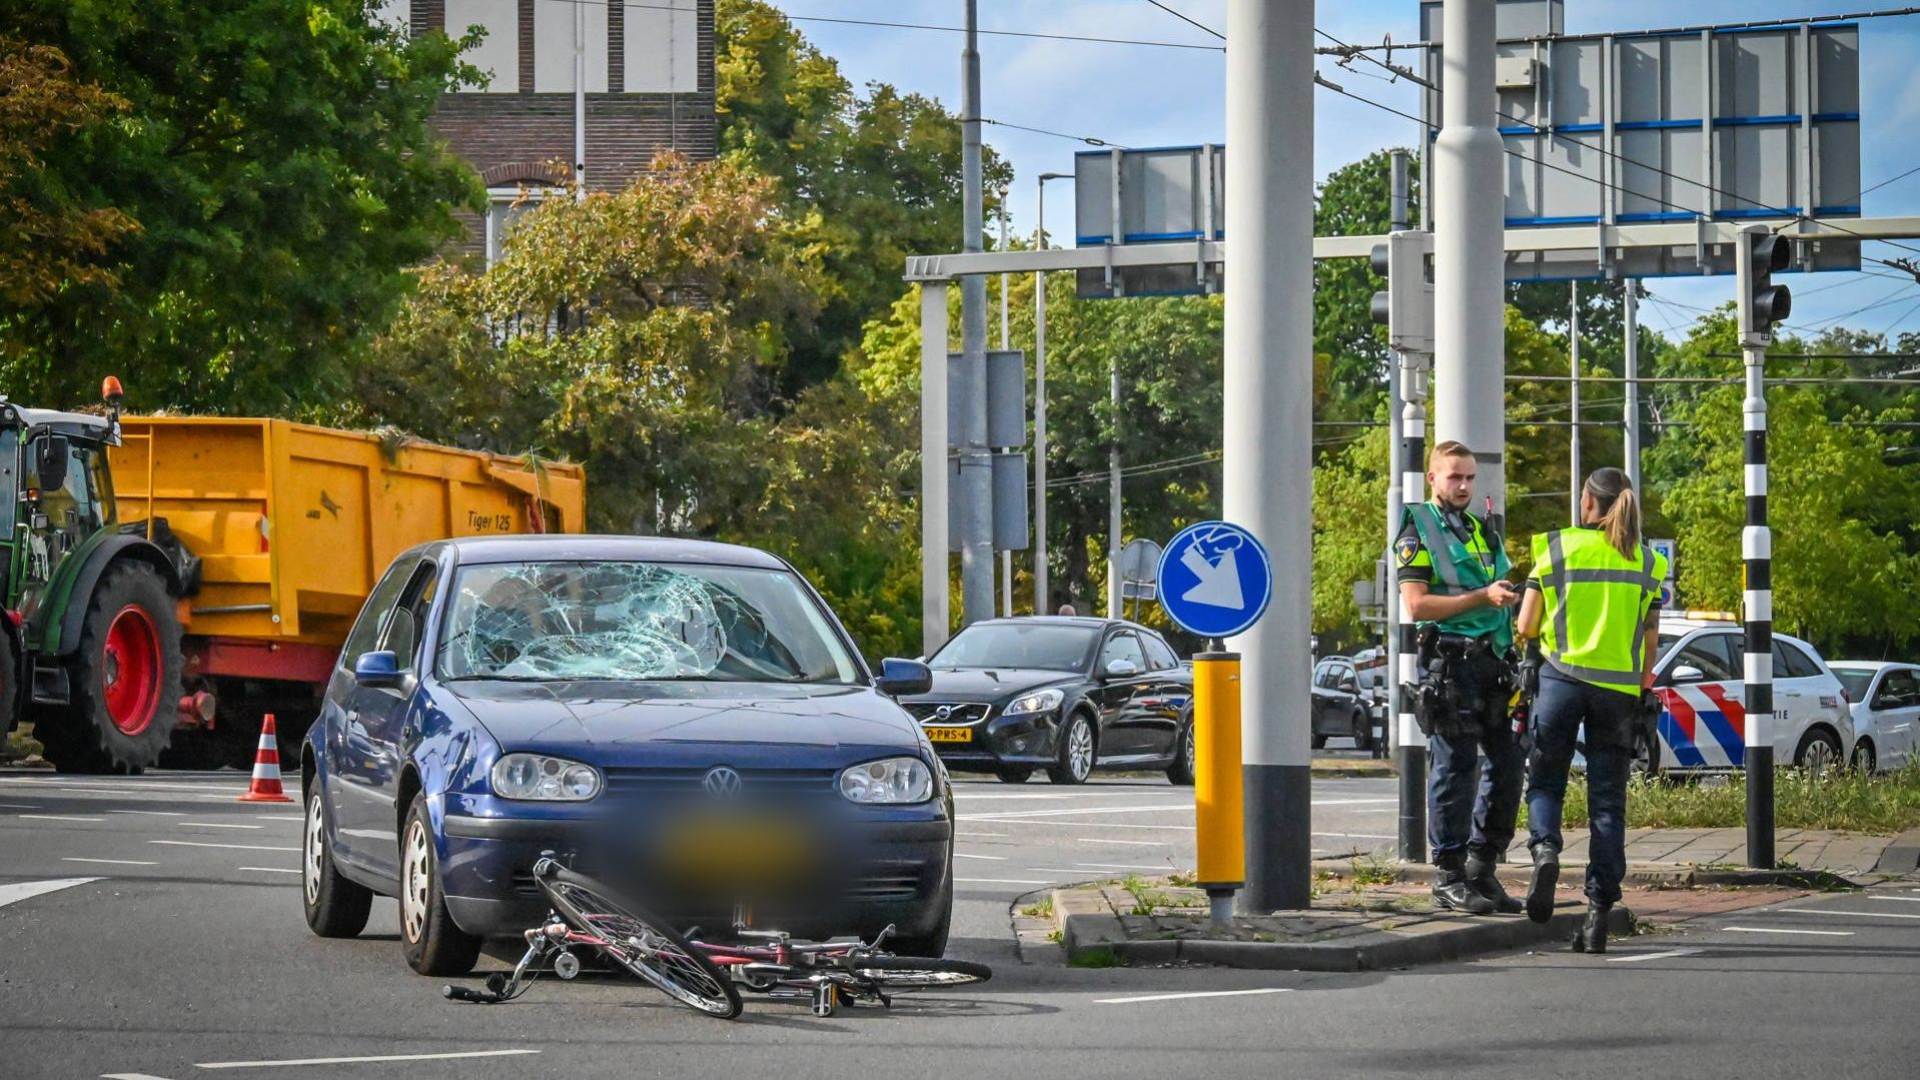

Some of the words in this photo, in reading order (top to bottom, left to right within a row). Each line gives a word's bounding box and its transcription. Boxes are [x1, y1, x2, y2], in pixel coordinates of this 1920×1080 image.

[468, 510, 492, 532] Tiger
[495, 514, 511, 531] 125
[1772, 709, 1788, 720] TIE
[926, 729, 968, 740] 0-PRS-4
